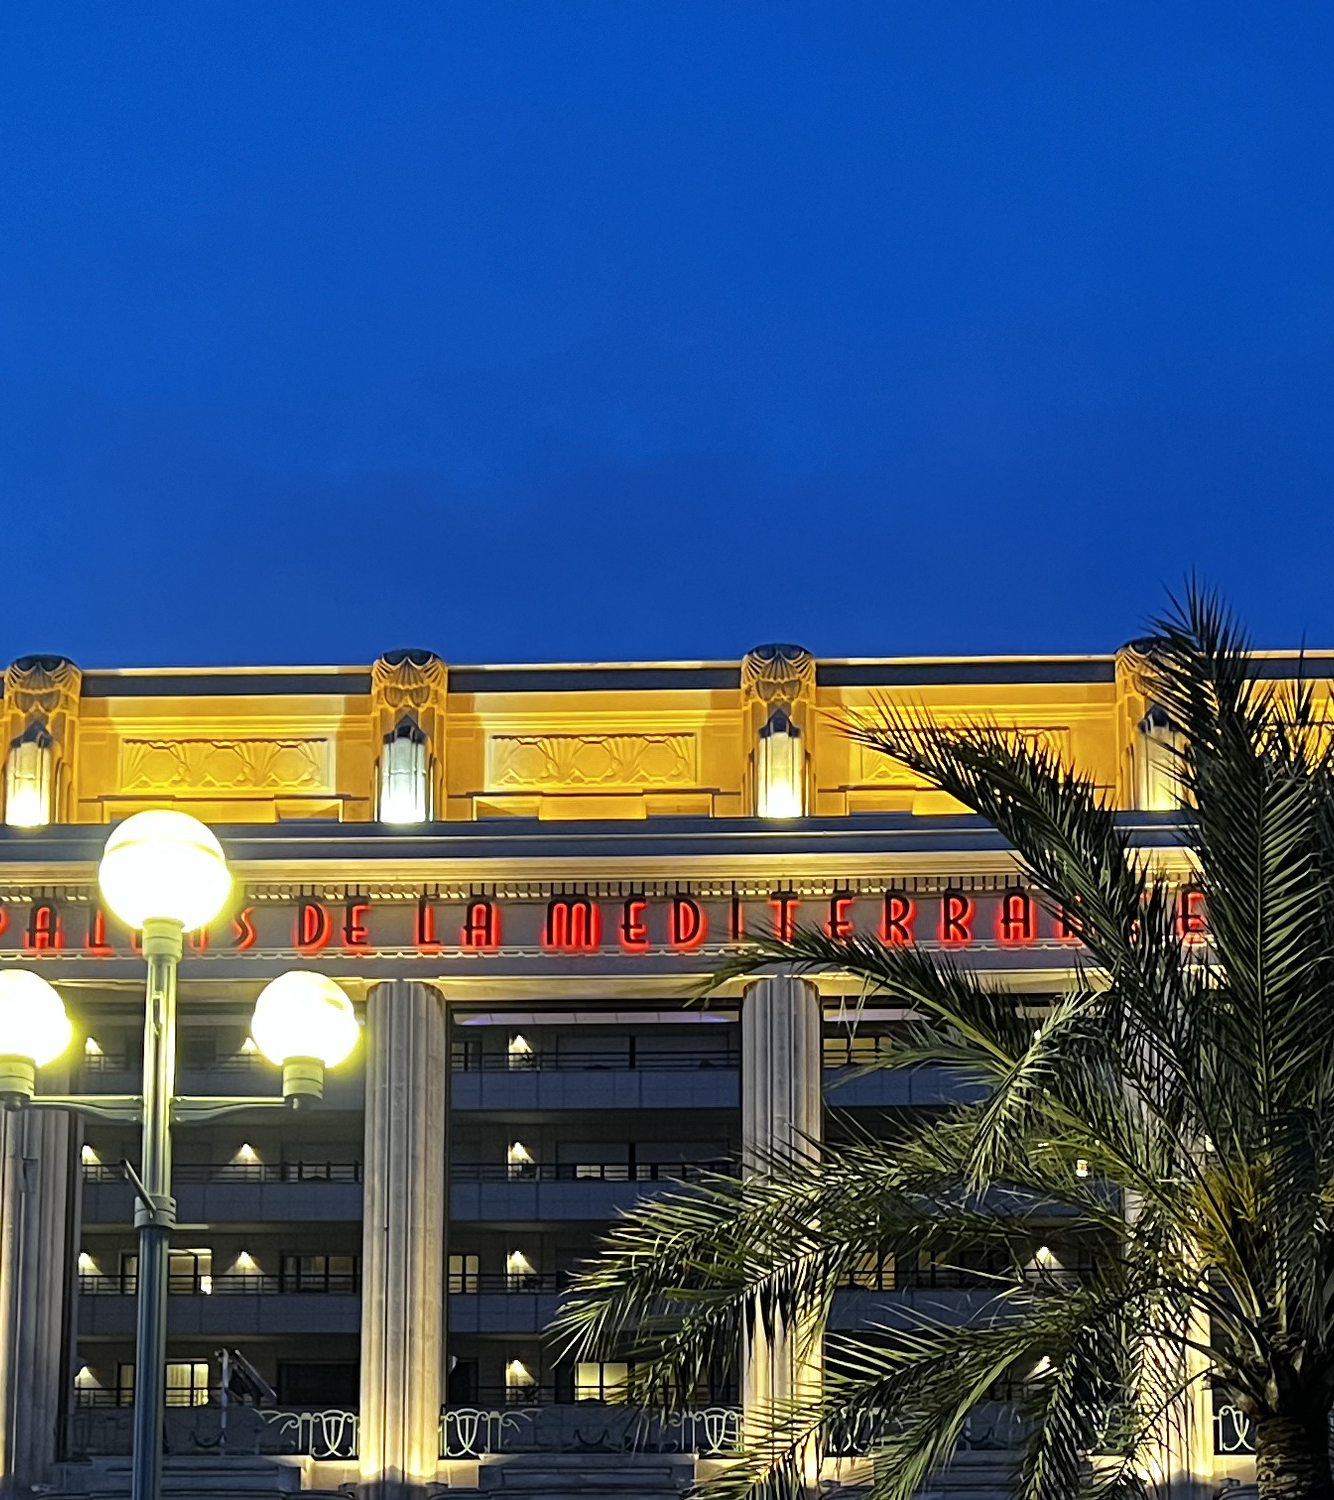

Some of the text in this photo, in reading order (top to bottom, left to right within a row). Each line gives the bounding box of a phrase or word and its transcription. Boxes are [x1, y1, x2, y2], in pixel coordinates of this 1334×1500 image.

[295, 895, 370, 949] DE
[415, 894, 501, 949] LA
[545, 890, 1208, 950] MEDITERRAE
